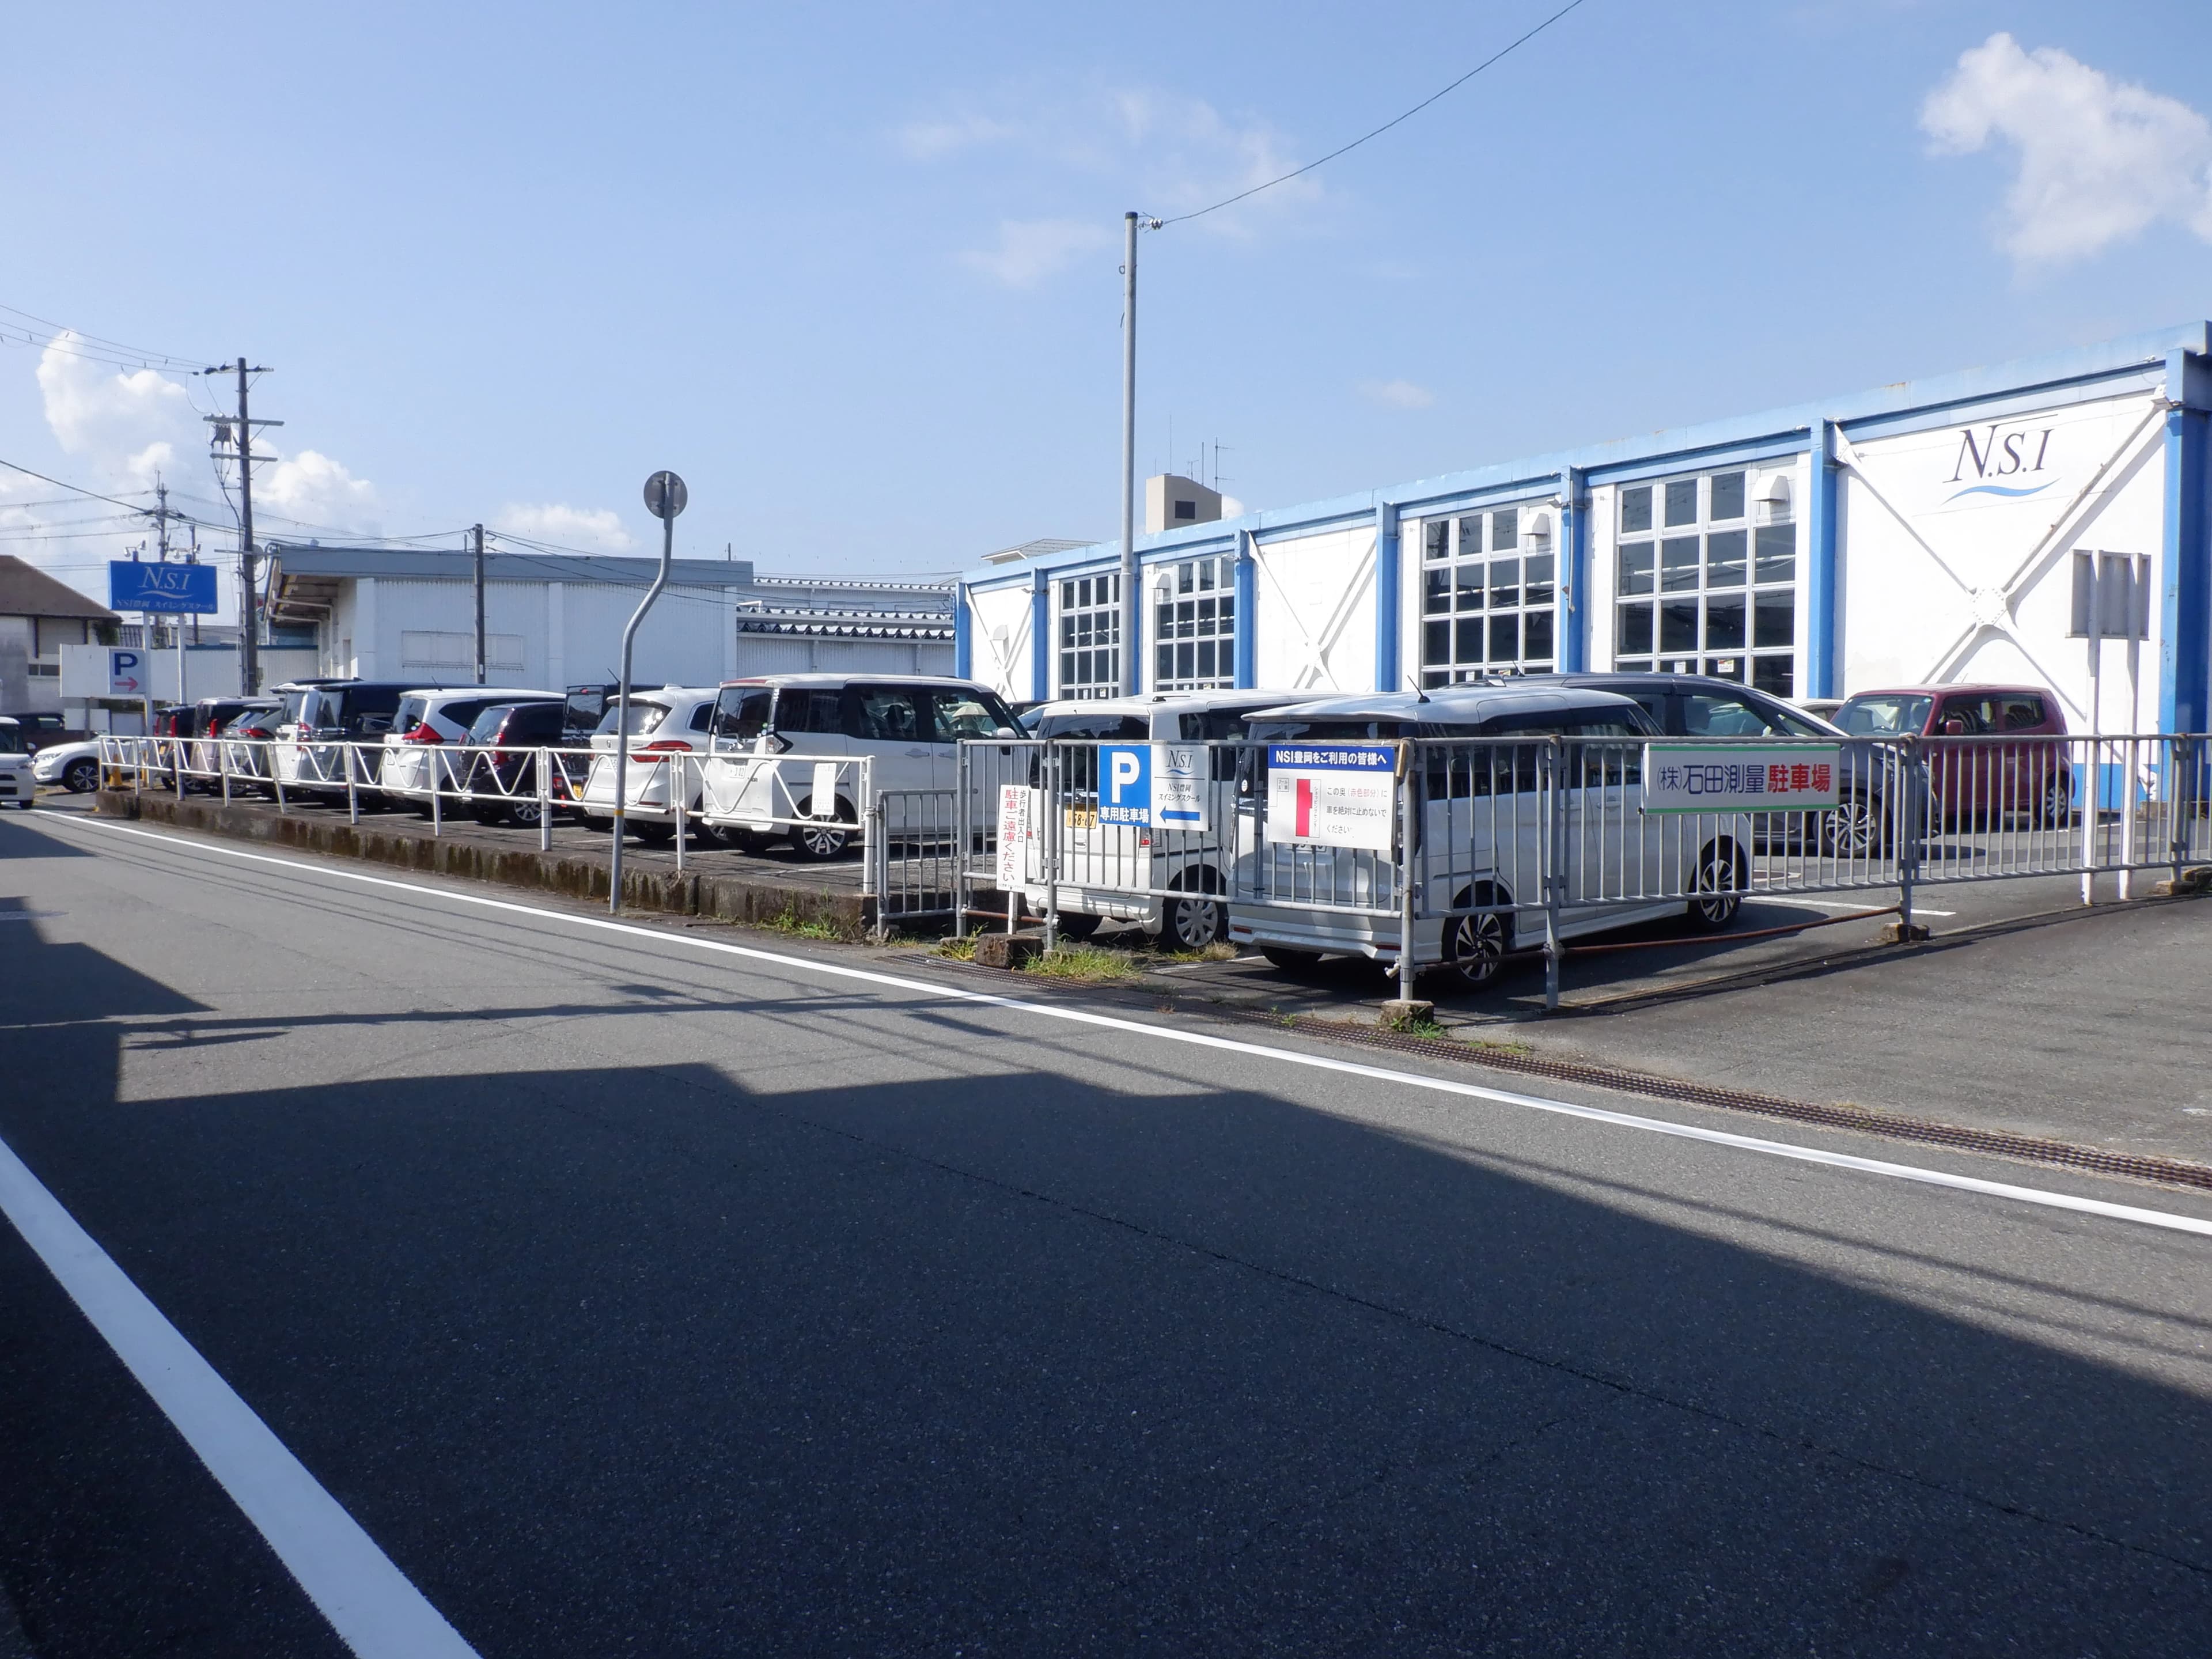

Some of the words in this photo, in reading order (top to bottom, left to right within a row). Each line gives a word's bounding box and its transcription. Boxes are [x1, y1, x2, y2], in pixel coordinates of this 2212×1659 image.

[114, 652, 138, 676] P
[1275, 750, 1387, 766] NSI豊岡をご利用の皆様へ
[1111, 751, 1140, 804] P
[1167, 783, 1192, 792] NSI豊岡
[1158, 793, 1201, 802] スイミングスクール
[1017, 790, 1027, 843] 歩行者出入口
[1100, 806, 1149, 824] 専用駐車場
[1002, 787, 1019, 881] 駐車ご遠慮ください
